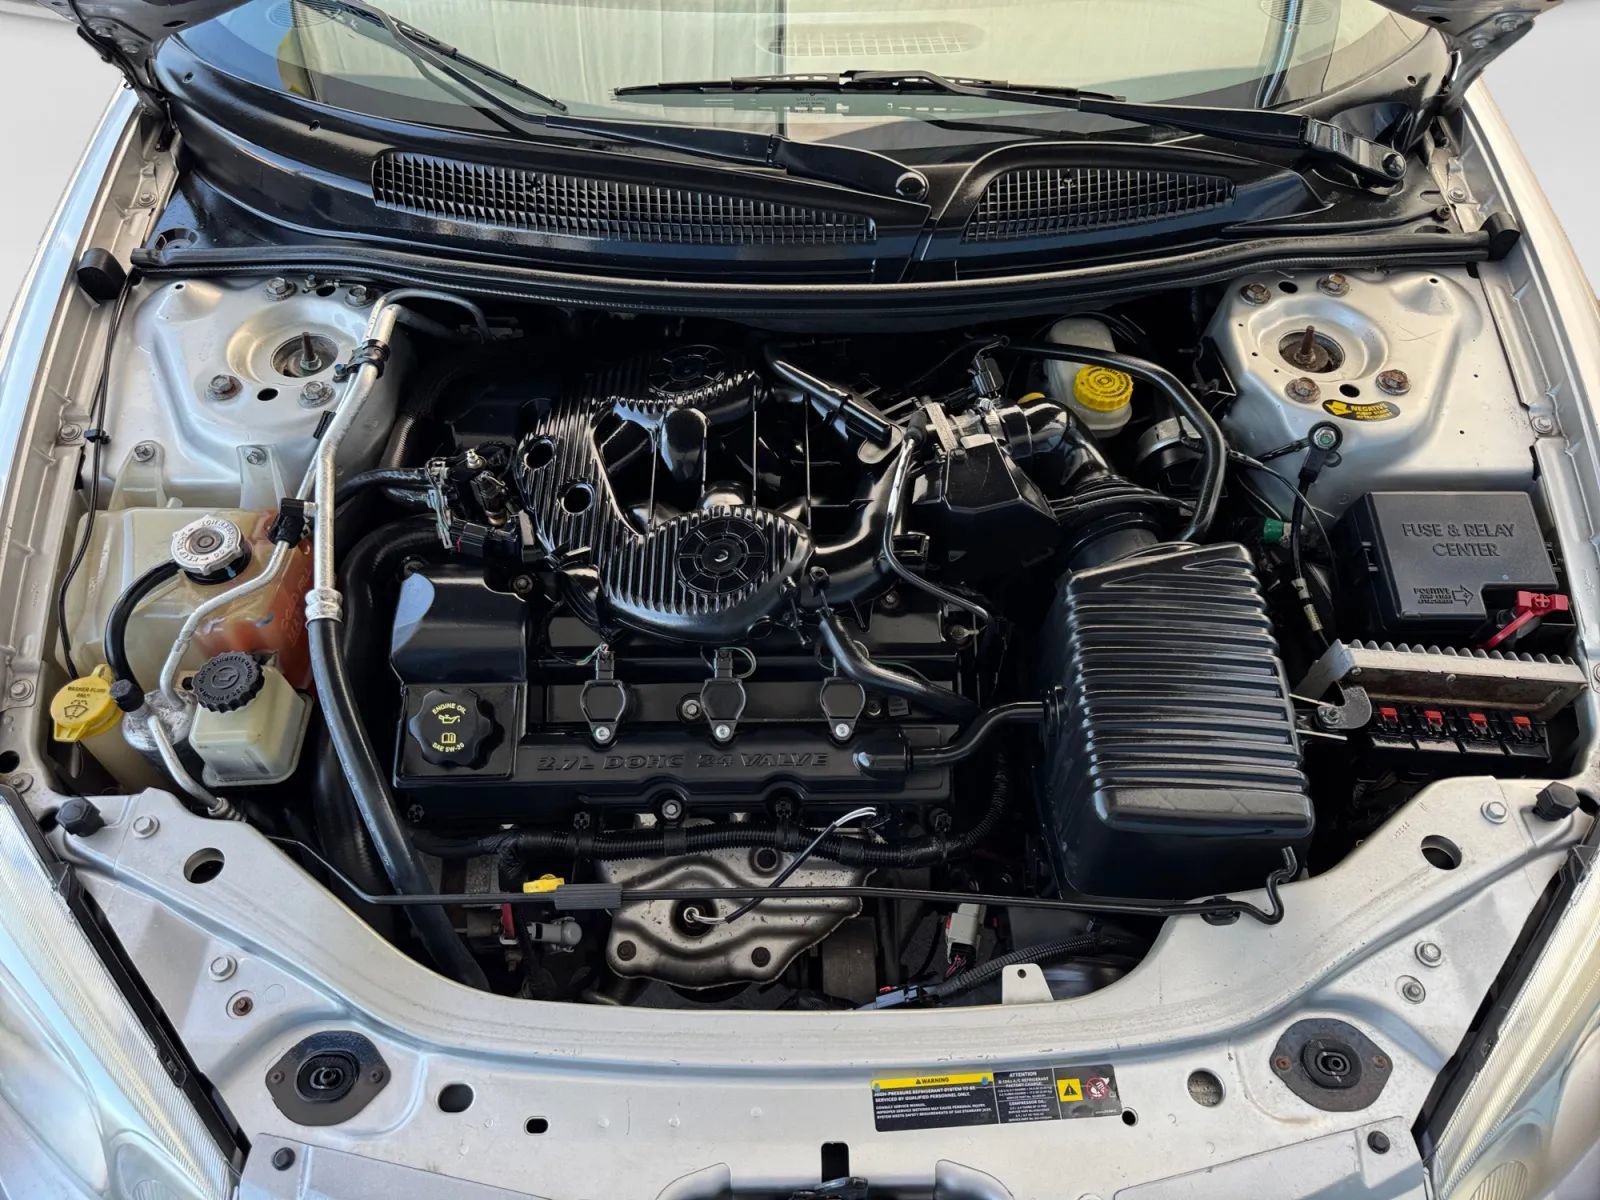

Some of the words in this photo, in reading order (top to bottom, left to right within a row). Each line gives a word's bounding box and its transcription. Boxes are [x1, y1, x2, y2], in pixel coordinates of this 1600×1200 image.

[1351, 403, 1388, 411] NEGATIVE
[1401, 523, 1443, 536] FUSE
[1448, 523, 1460, 536] &
[1464, 523, 1515, 537] RELAY
[1432, 543, 1501, 556] CENTER
[432, 702, 456, 715] ENGINE
[457, 704, 466, 714] OIL
[432, 742, 444, 752] SAE
[537, 755, 594, 771] 2.7L
[603, 754, 684, 769] DOHC
[696, 754, 733, 767] 24
[741, 753, 828, 767] VALVE
